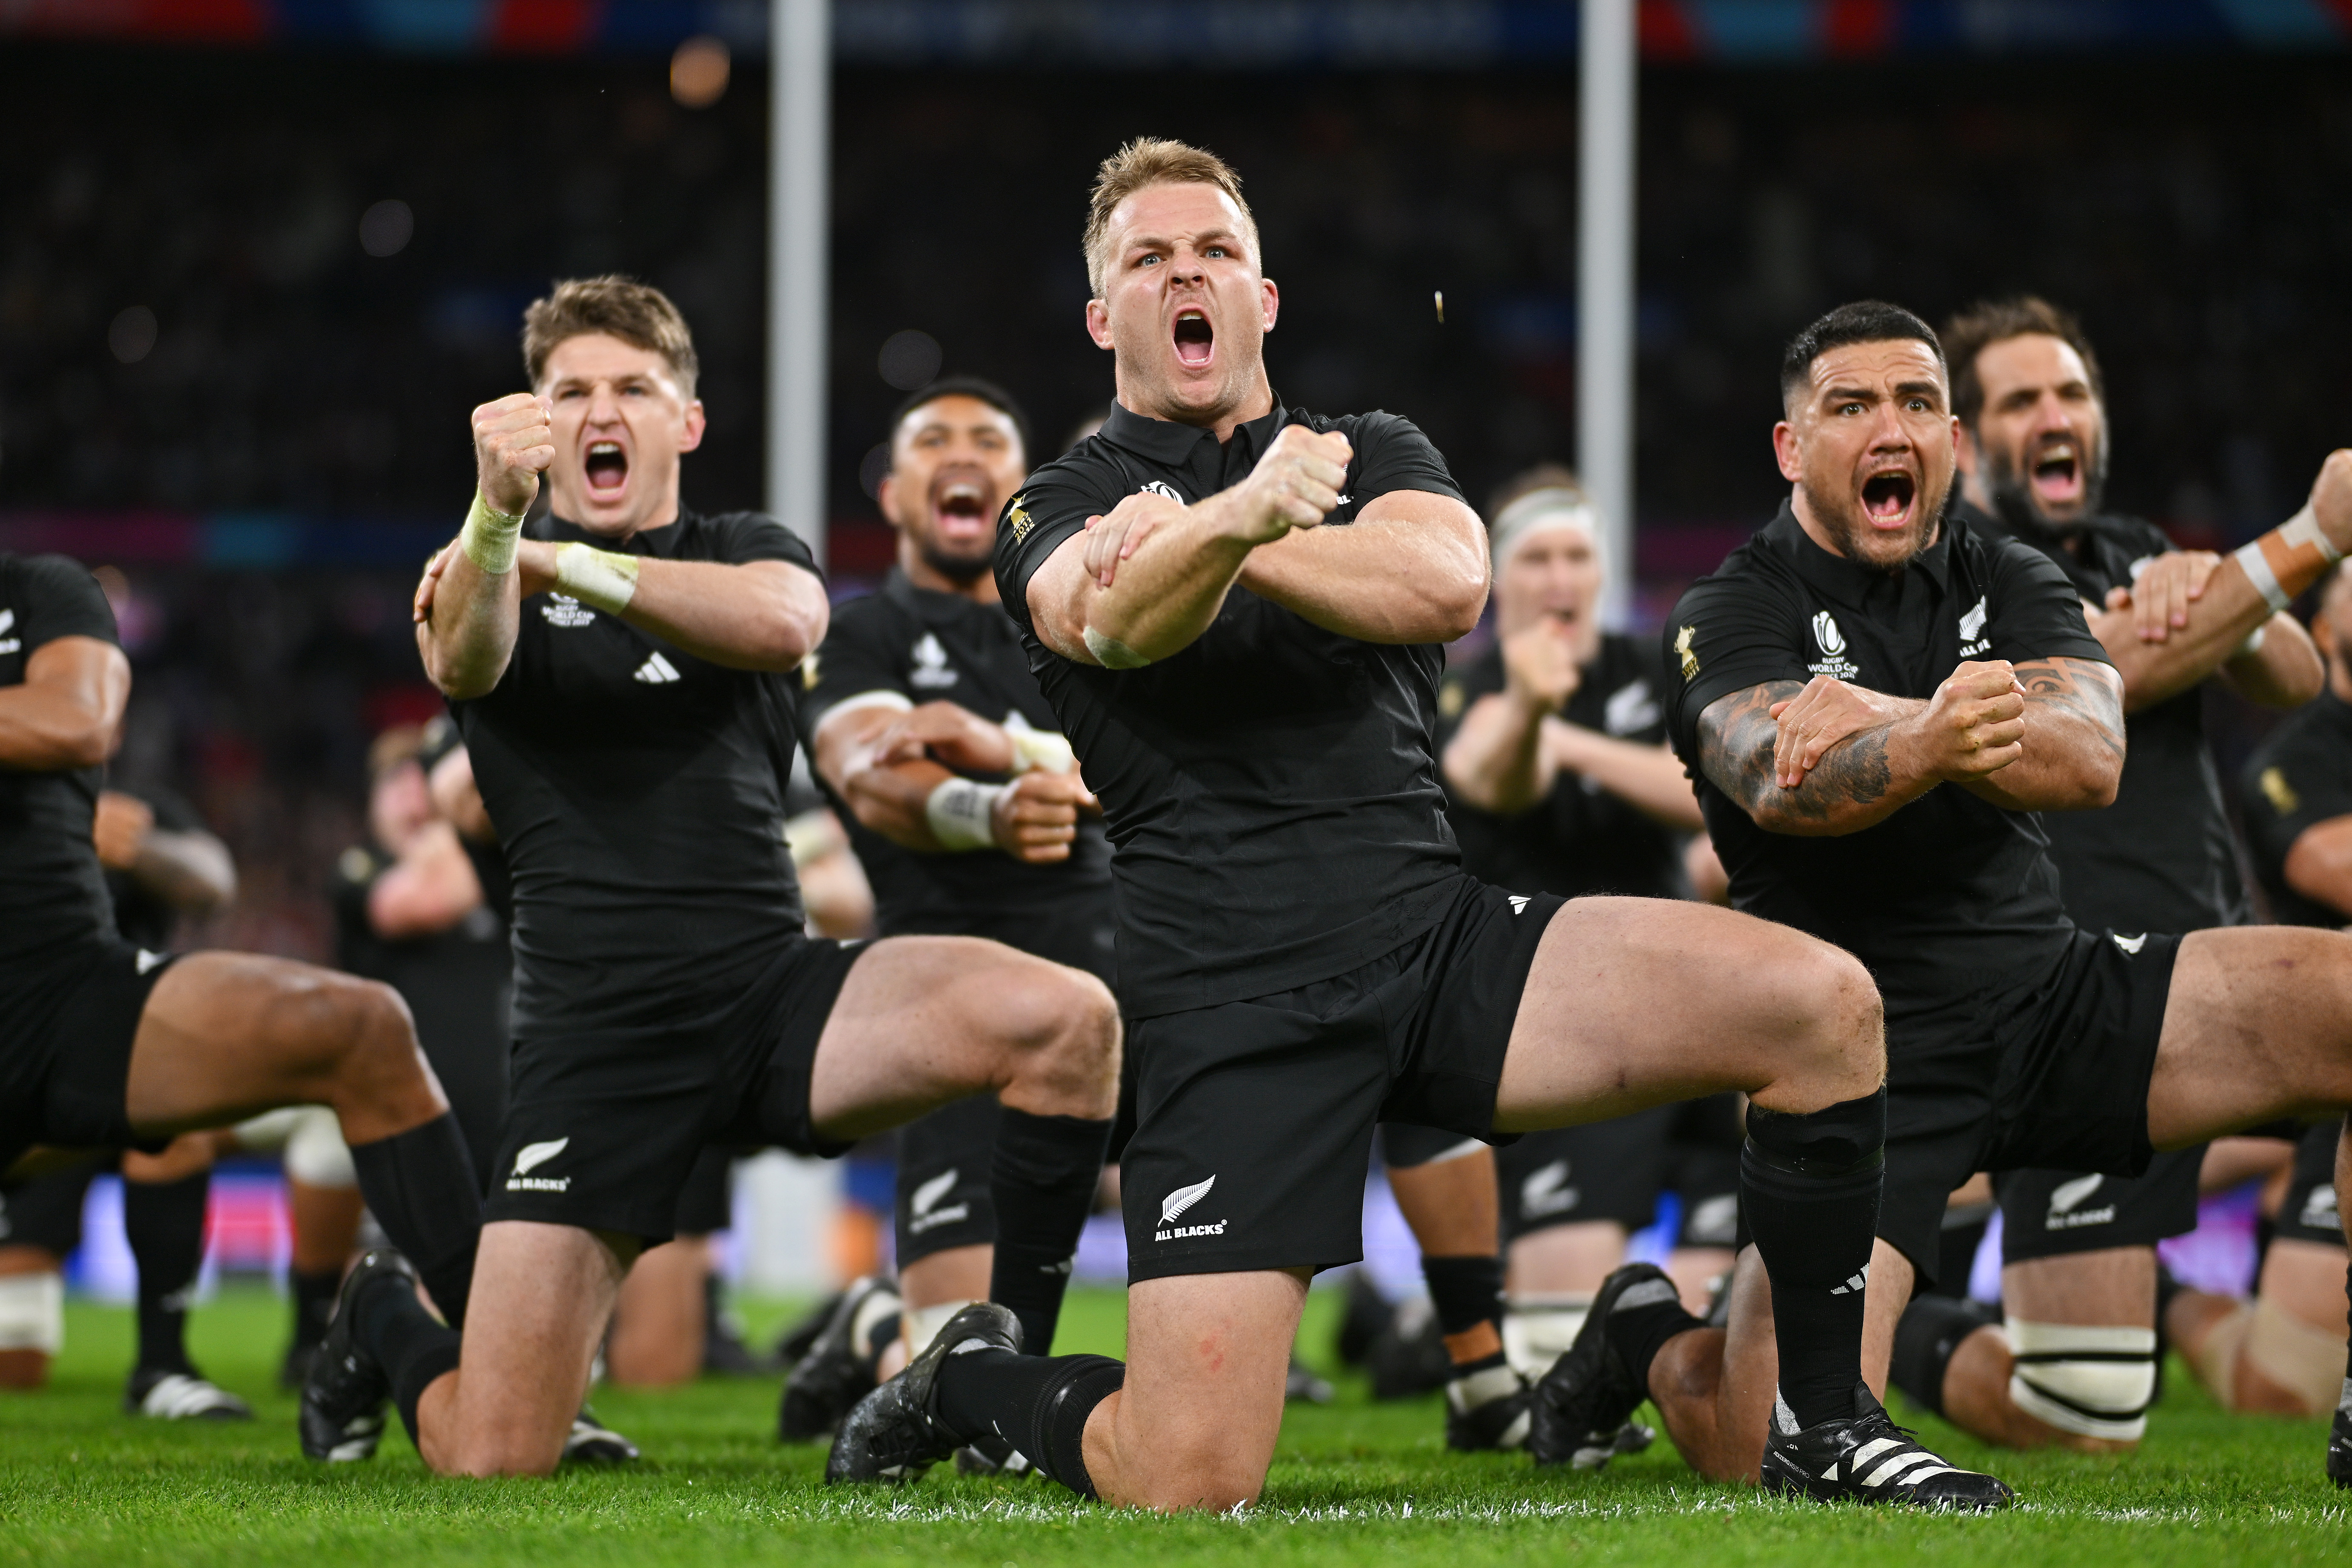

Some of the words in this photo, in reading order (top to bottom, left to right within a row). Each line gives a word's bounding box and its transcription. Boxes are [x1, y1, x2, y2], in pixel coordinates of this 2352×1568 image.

[1014, 516, 1032, 541] 2011
[1822, 656, 1844, 664] RUGBY
[1807, 664, 1842, 673] WORLD
[1155, 1229, 1172, 1241] ALL
[1174, 1224, 1224, 1238] BLACKS
[1799, 1468, 1810, 1479] PRO
